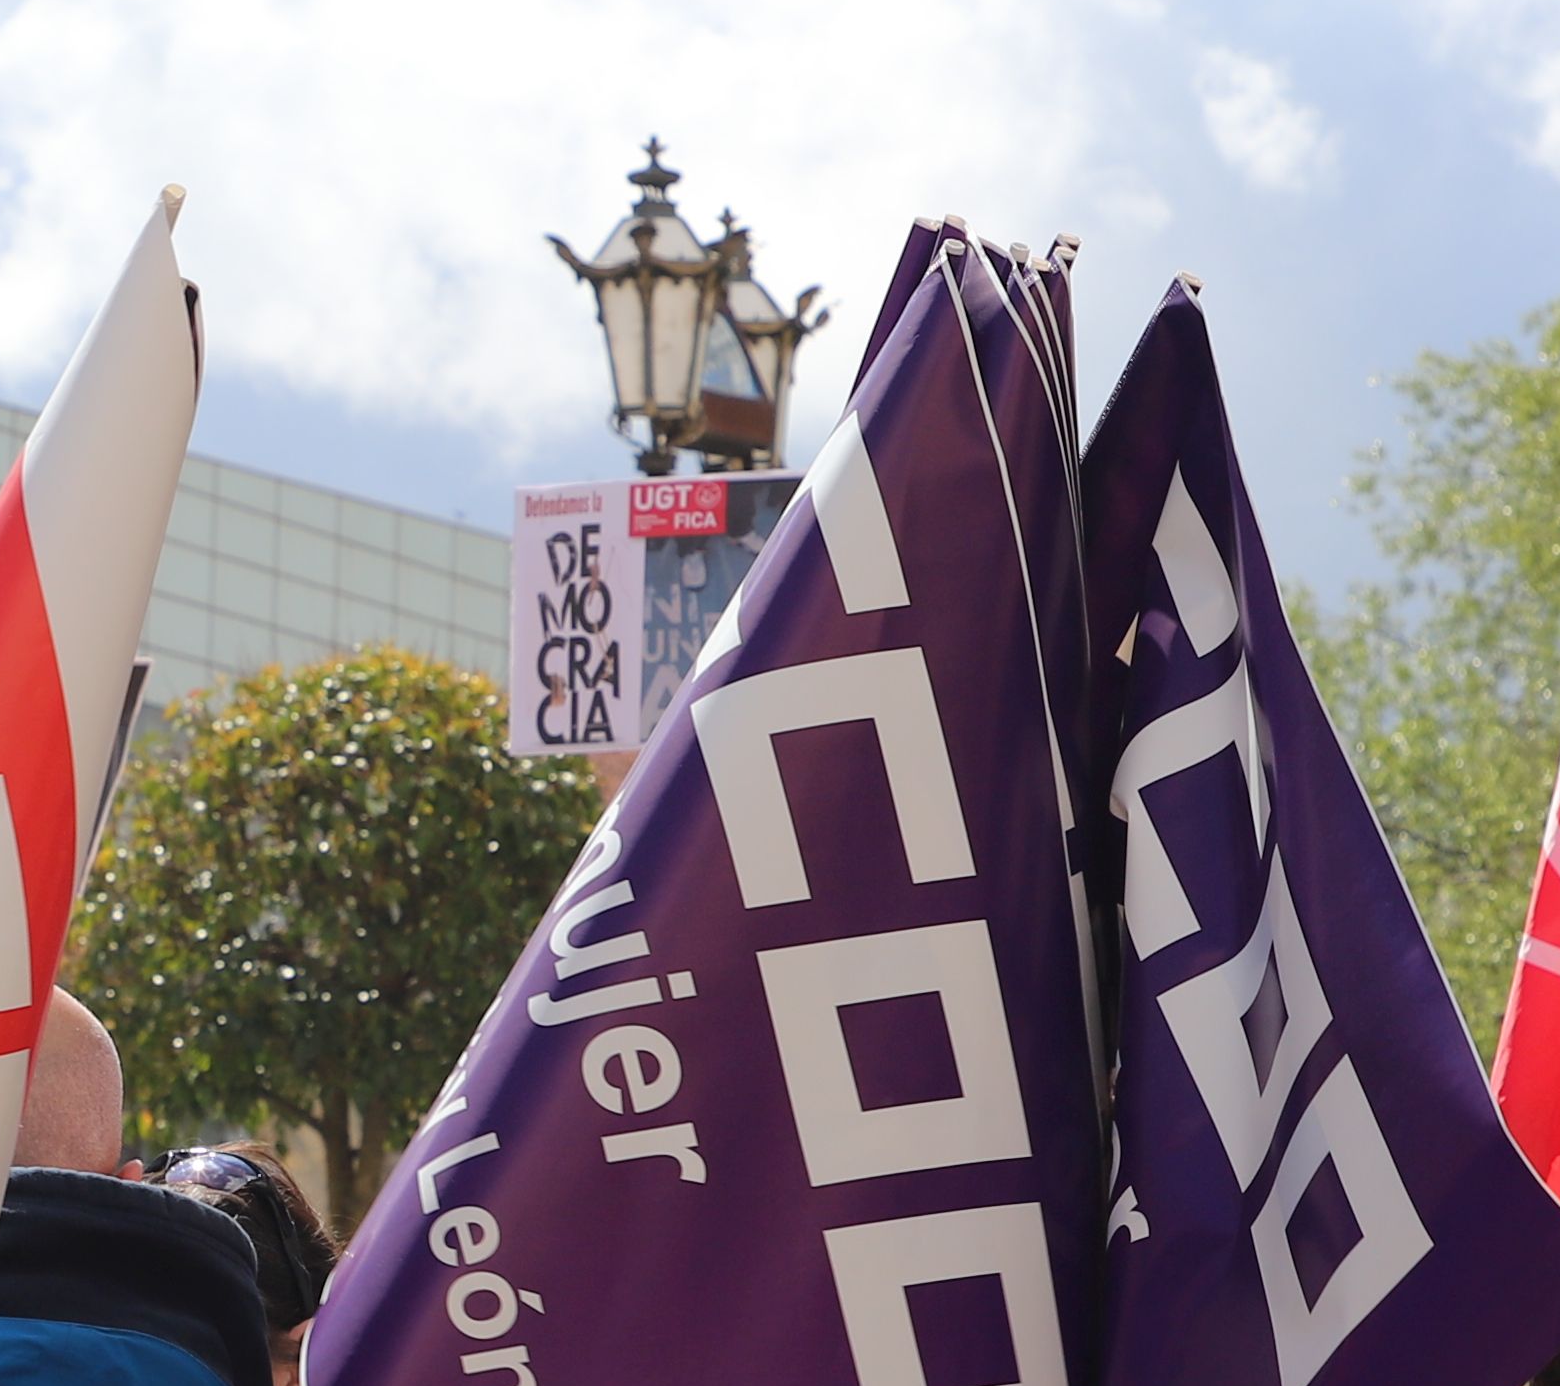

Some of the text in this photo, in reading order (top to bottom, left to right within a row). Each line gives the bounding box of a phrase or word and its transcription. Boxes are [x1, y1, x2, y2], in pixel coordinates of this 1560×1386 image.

[633, 484, 693, 512] UGT
[673, 511, 717, 530] FICA
[546, 524, 601, 585] DE
[537, 580, 612, 635] MO
[537, 635, 620, 699] CRA
[536, 690, 614, 745] CIA
